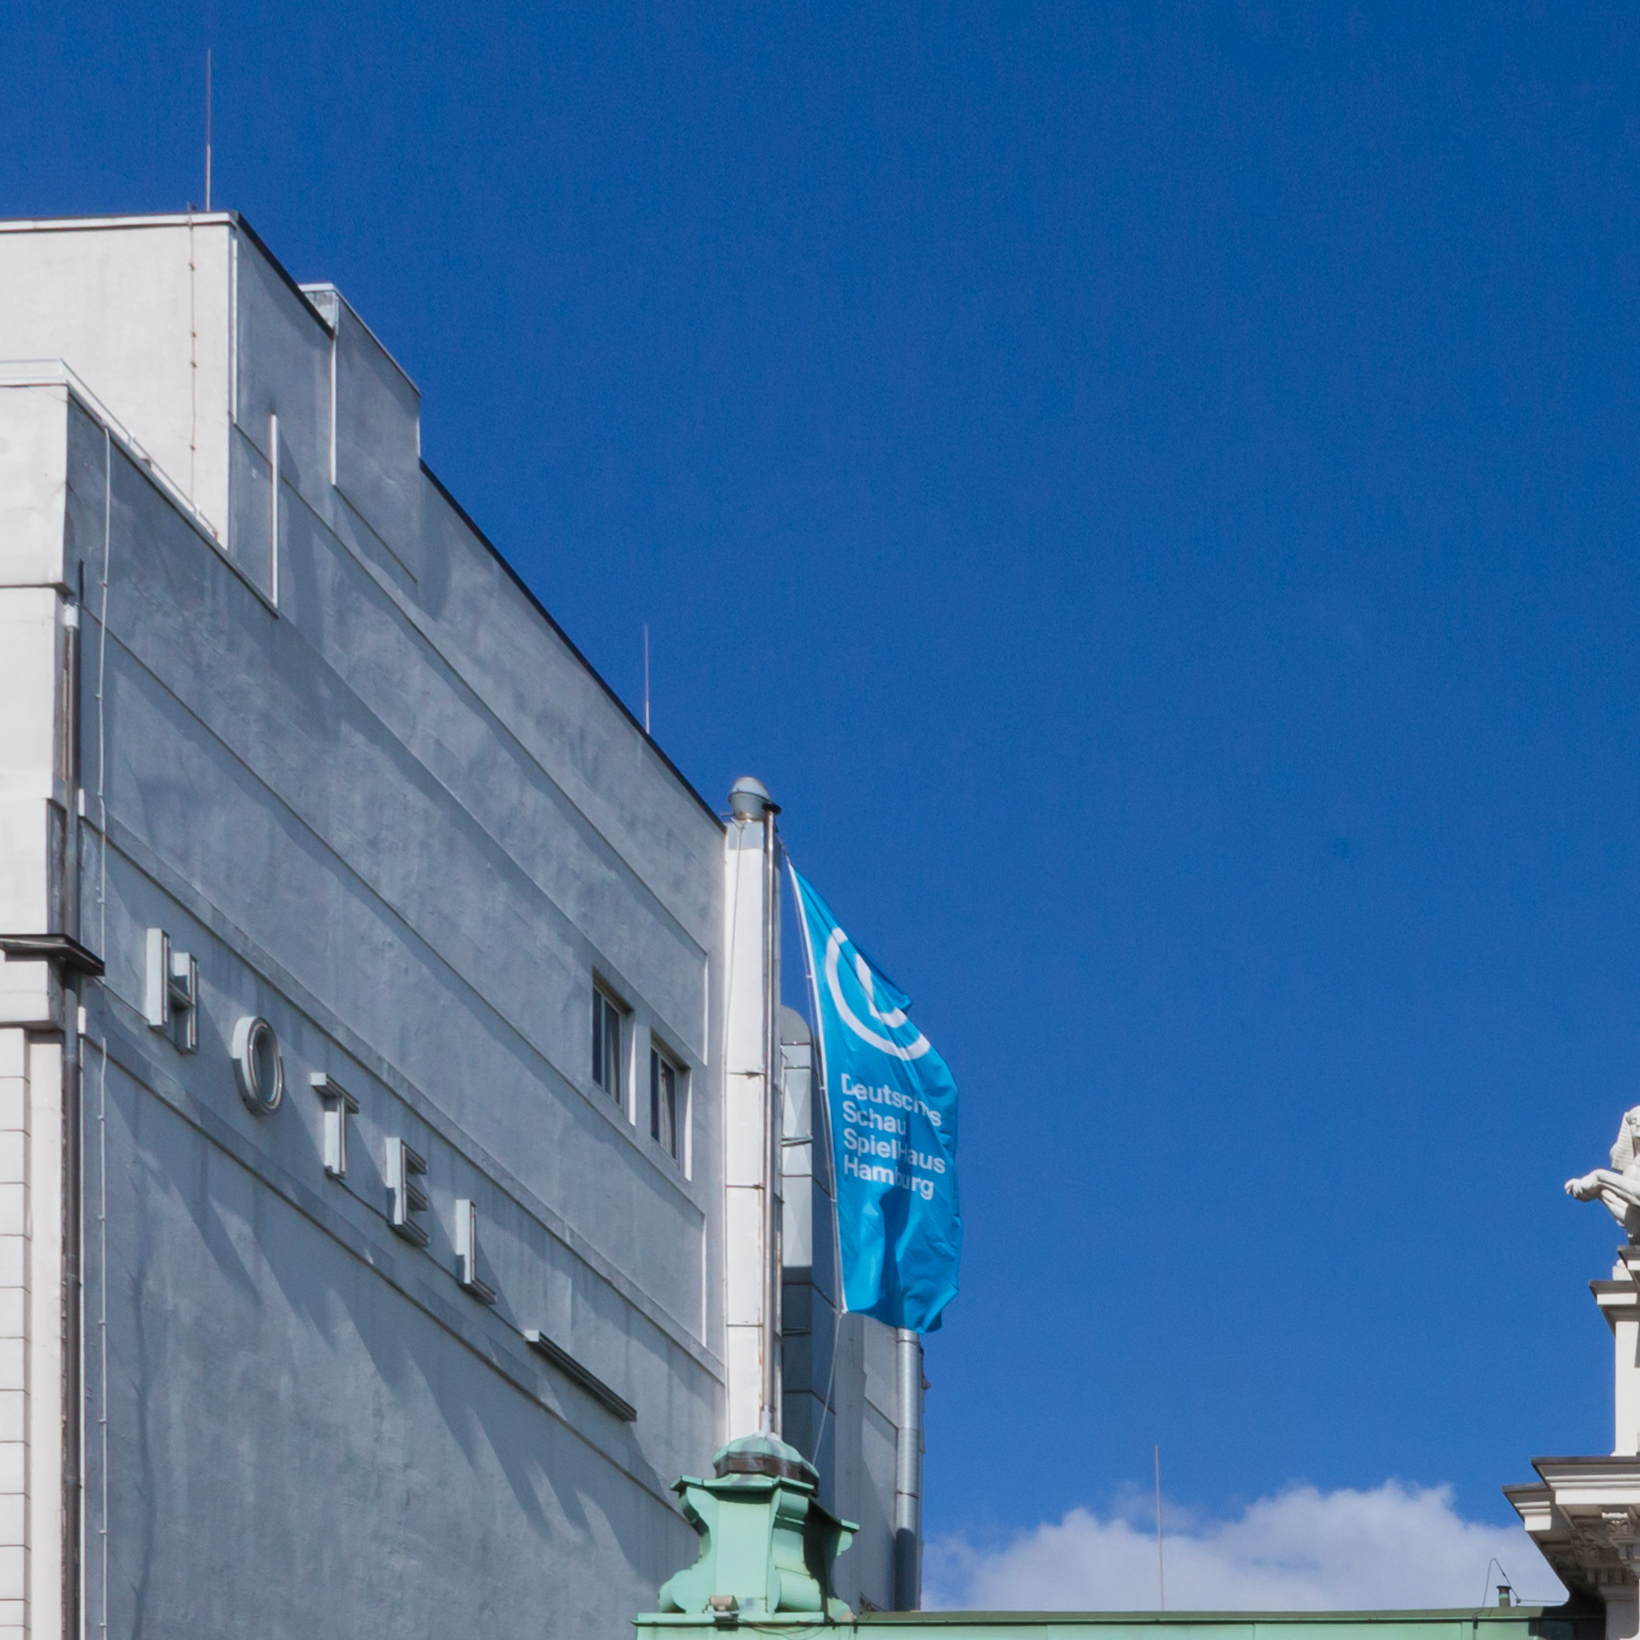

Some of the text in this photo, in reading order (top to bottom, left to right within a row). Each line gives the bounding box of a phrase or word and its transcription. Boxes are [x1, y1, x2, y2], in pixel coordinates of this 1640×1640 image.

[842, 1100, 907, 1136] Schau
[843, 1127, 946, 1174] SpielHaus
[844, 1154, 935, 1201] Hamburg
